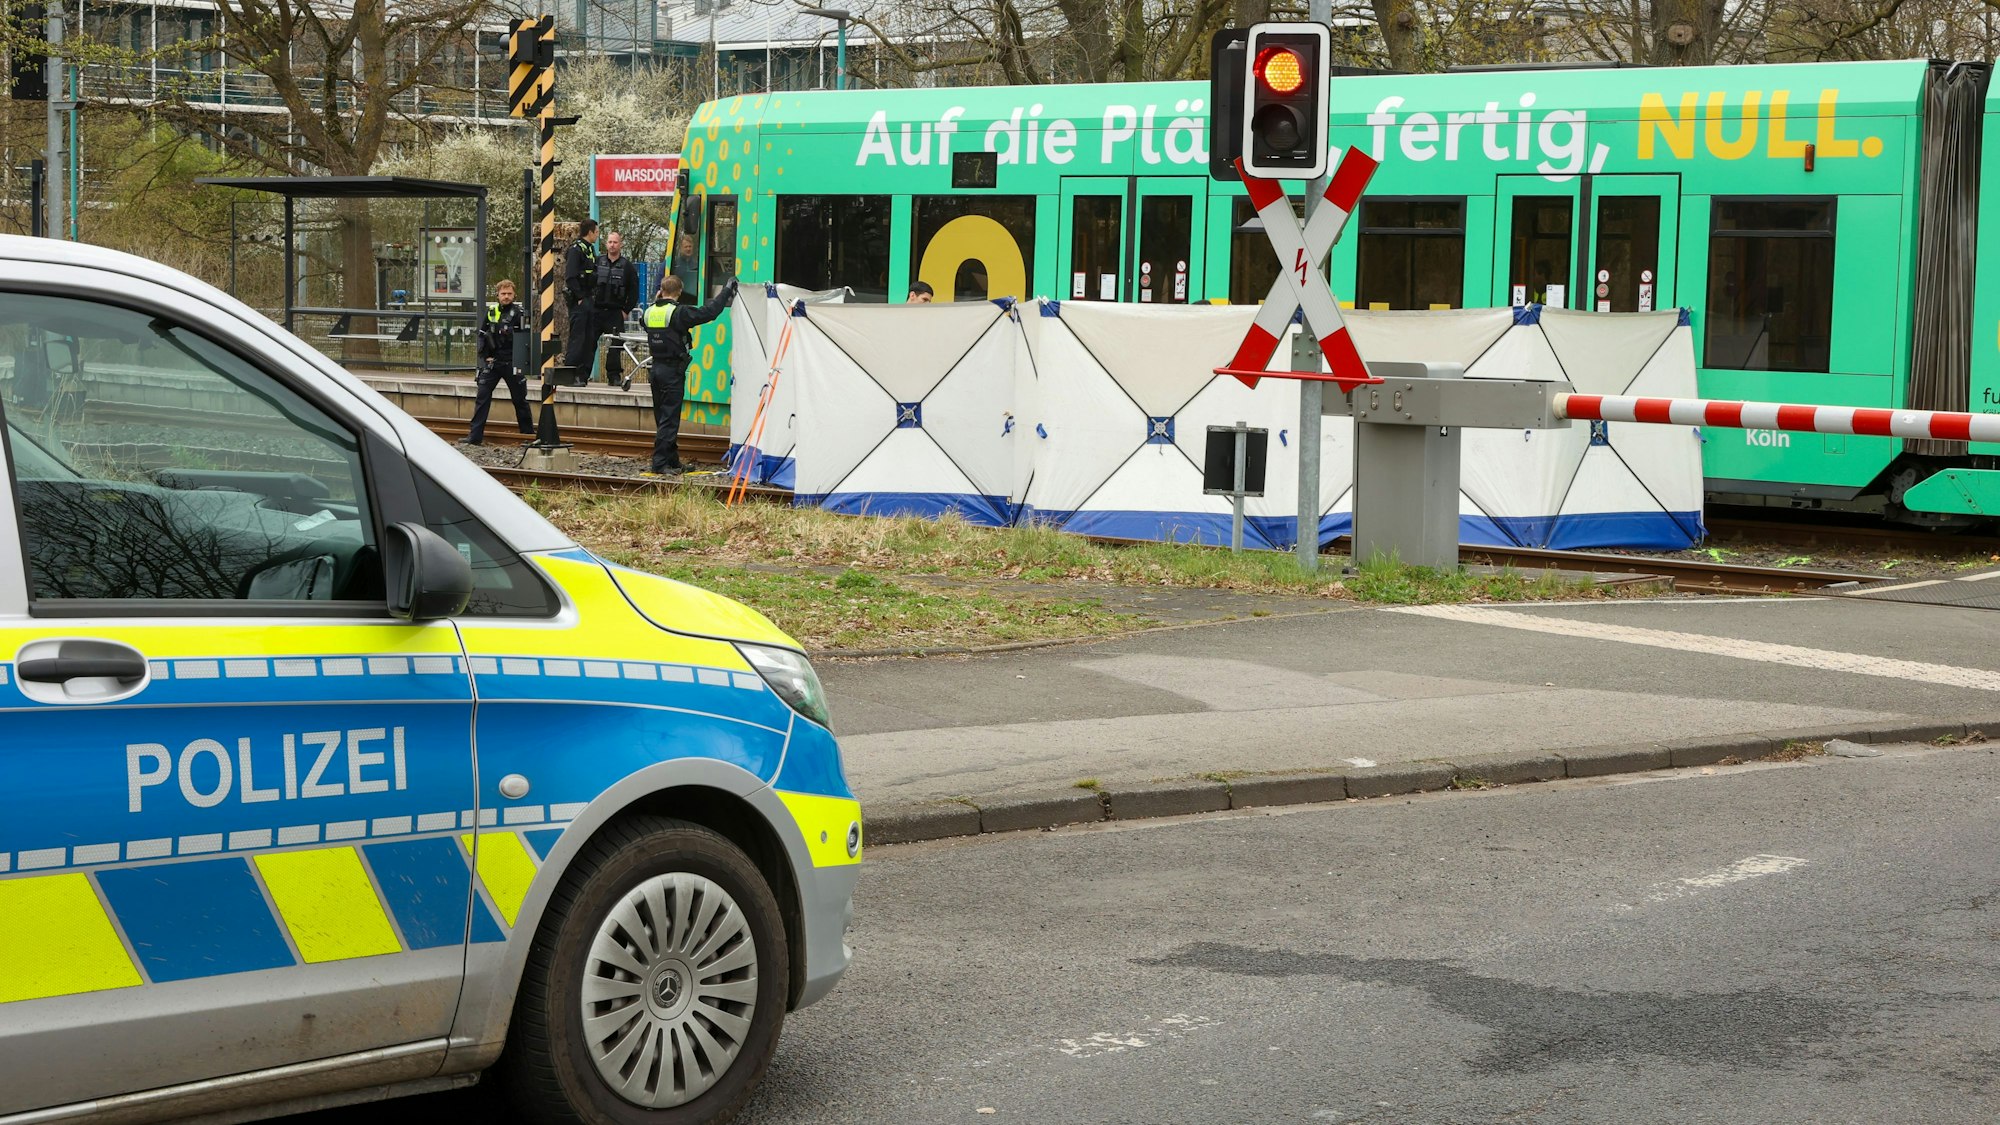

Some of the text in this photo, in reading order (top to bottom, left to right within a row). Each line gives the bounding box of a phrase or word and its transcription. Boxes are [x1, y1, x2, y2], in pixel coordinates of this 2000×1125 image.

[855, 106, 966, 166] Auf
[984, 103, 1077, 165] die
[1367, 92, 1610, 182] fertig,
[1637, 89, 1884, 160] NULL.
[614, 168, 679, 183] MARSDORF
[1440, 426, 1448, 436] 4
[1745, 428, 1790, 448] Köln
[126, 726, 407, 813] POLIZEI
